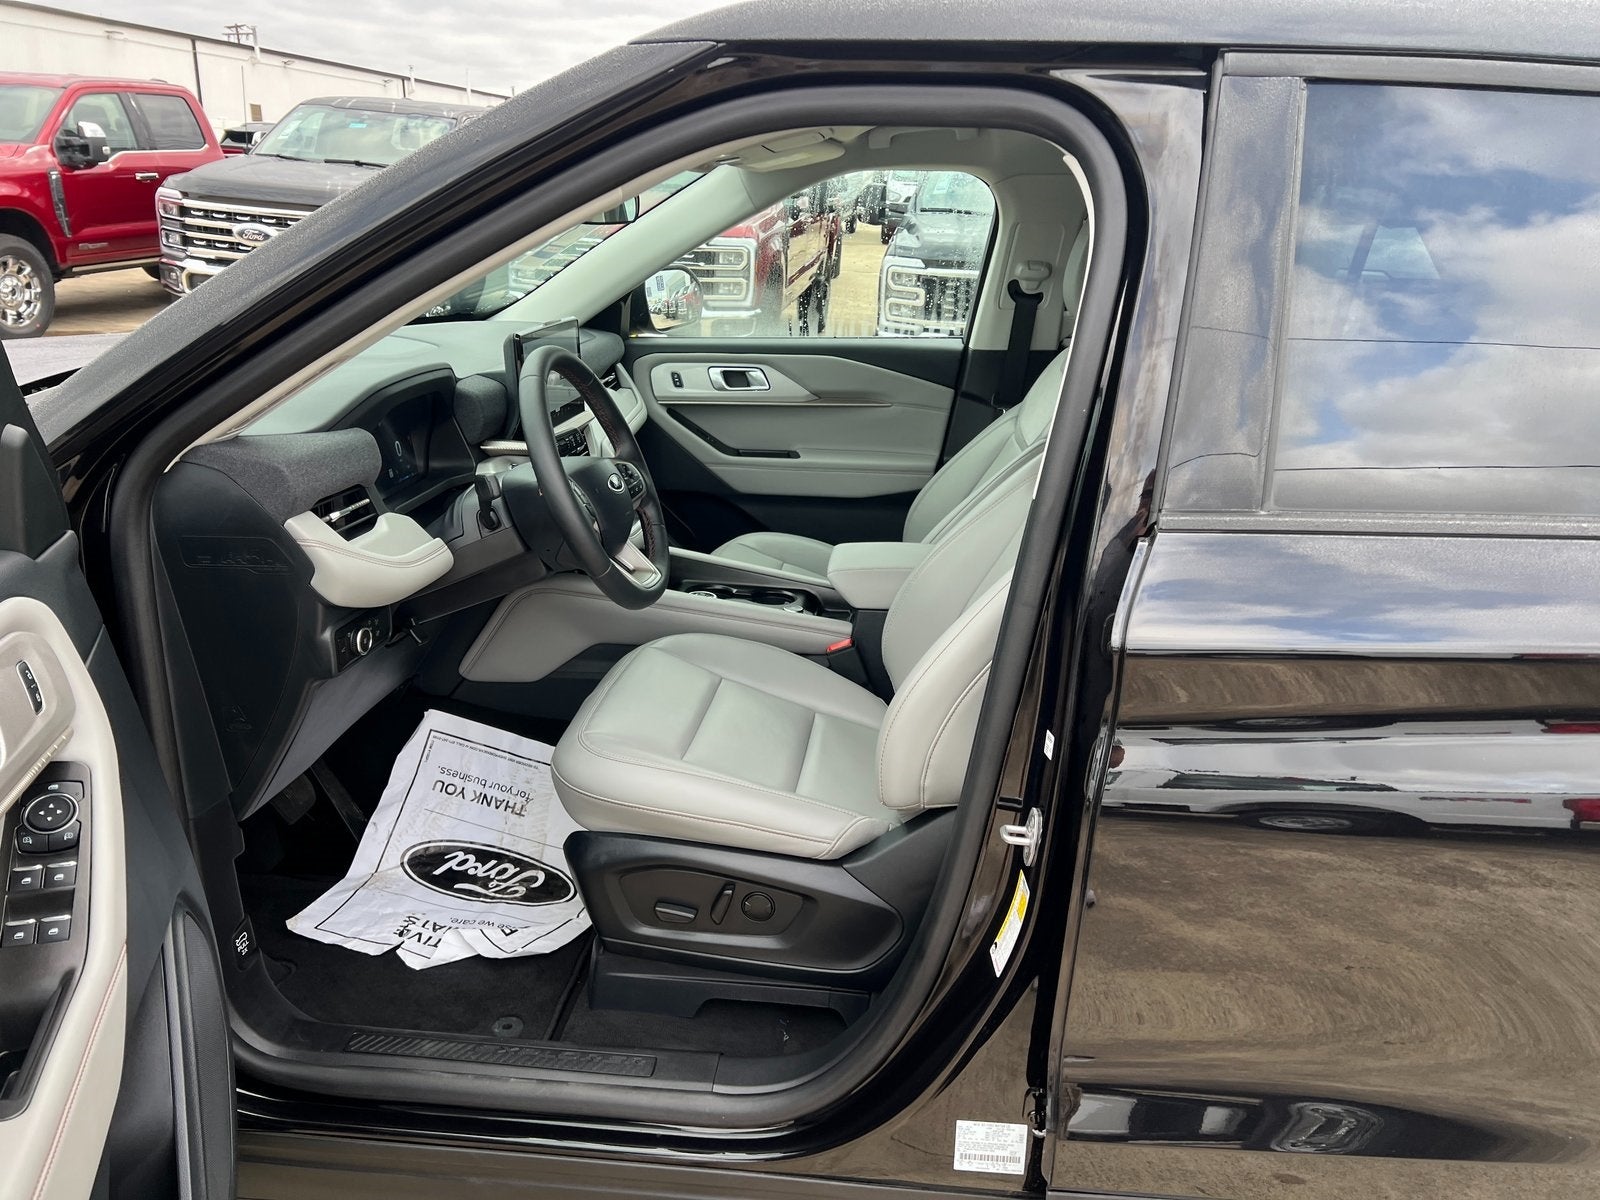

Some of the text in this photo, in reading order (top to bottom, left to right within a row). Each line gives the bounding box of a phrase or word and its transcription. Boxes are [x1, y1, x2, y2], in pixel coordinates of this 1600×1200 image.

[242, 230, 264, 241] Ford
[432, 779, 526, 818] THANK YOU
[438, 765, 533, 802] for your business.
[432, 850, 546, 898] Ford
[477, 919, 495, 927] we
